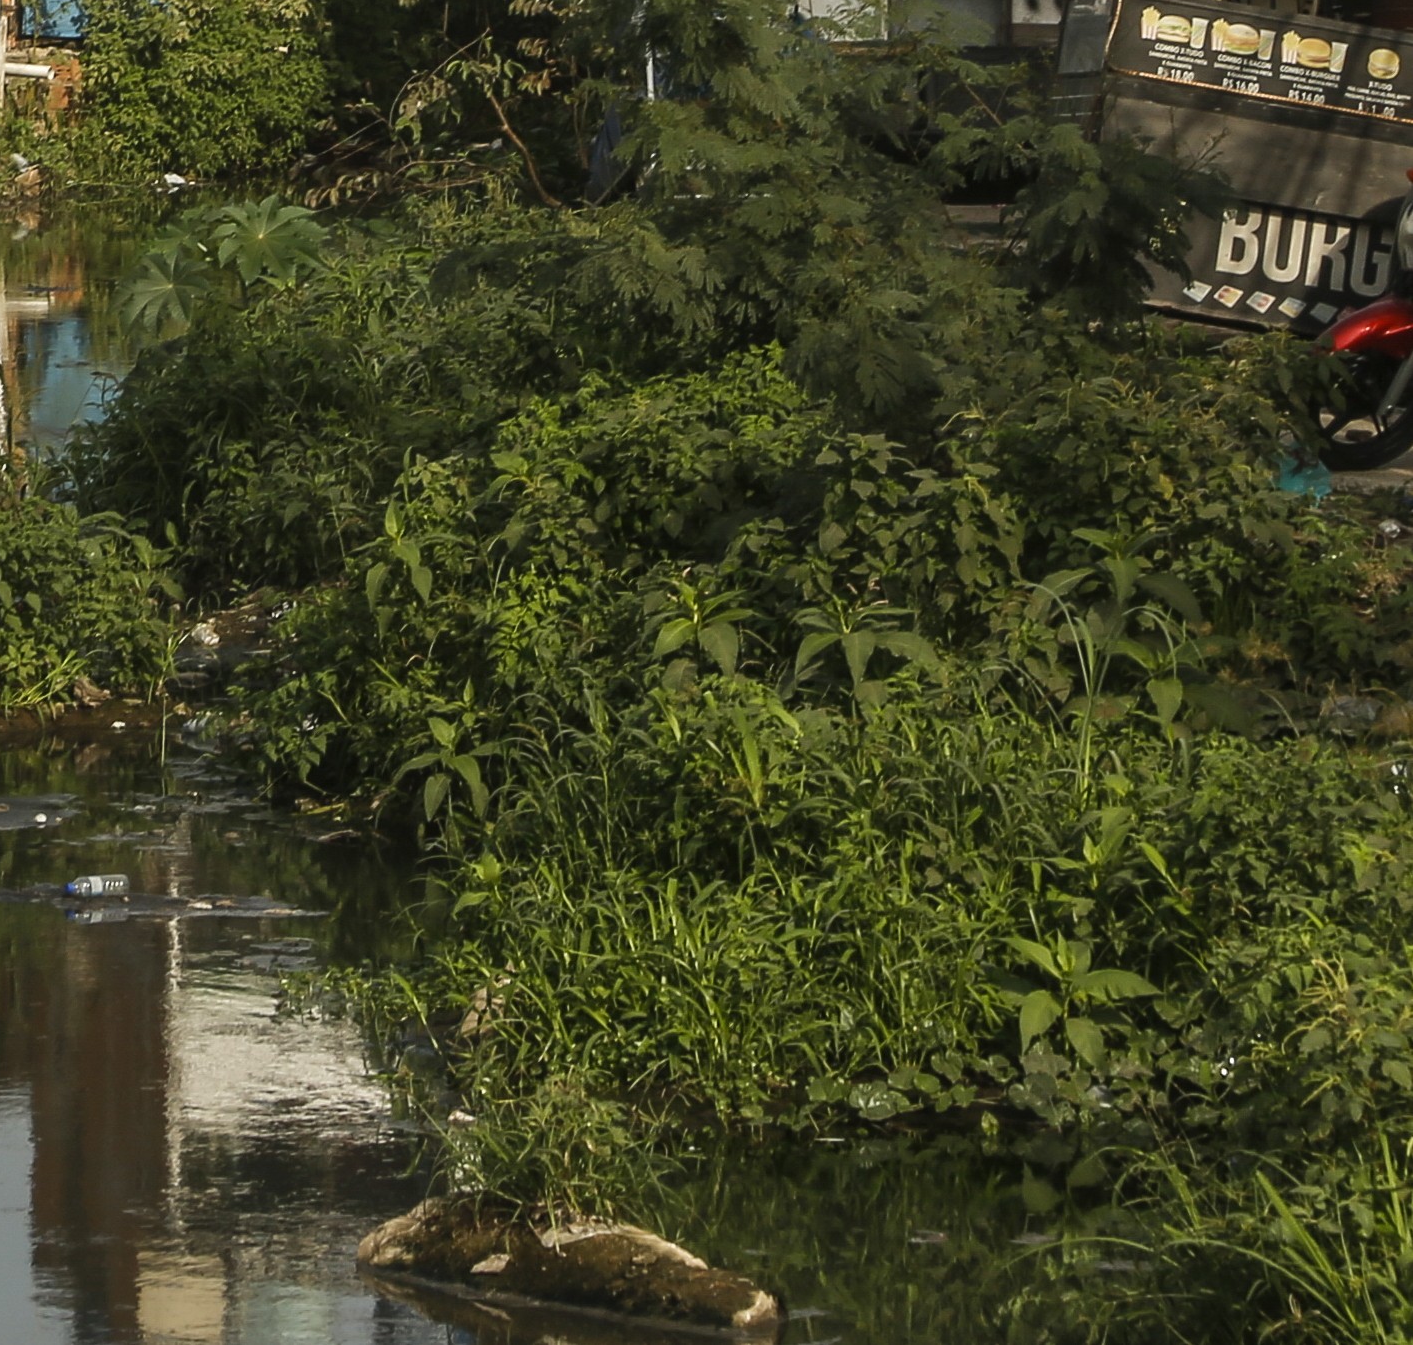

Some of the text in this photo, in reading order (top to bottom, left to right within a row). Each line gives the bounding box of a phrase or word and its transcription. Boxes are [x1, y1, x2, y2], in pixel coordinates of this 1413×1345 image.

[1154, 43, 1180, 54] COMBO
[1217, 53, 1242, 65] COMBO
[1279, 65, 1304, 76] COMBO
